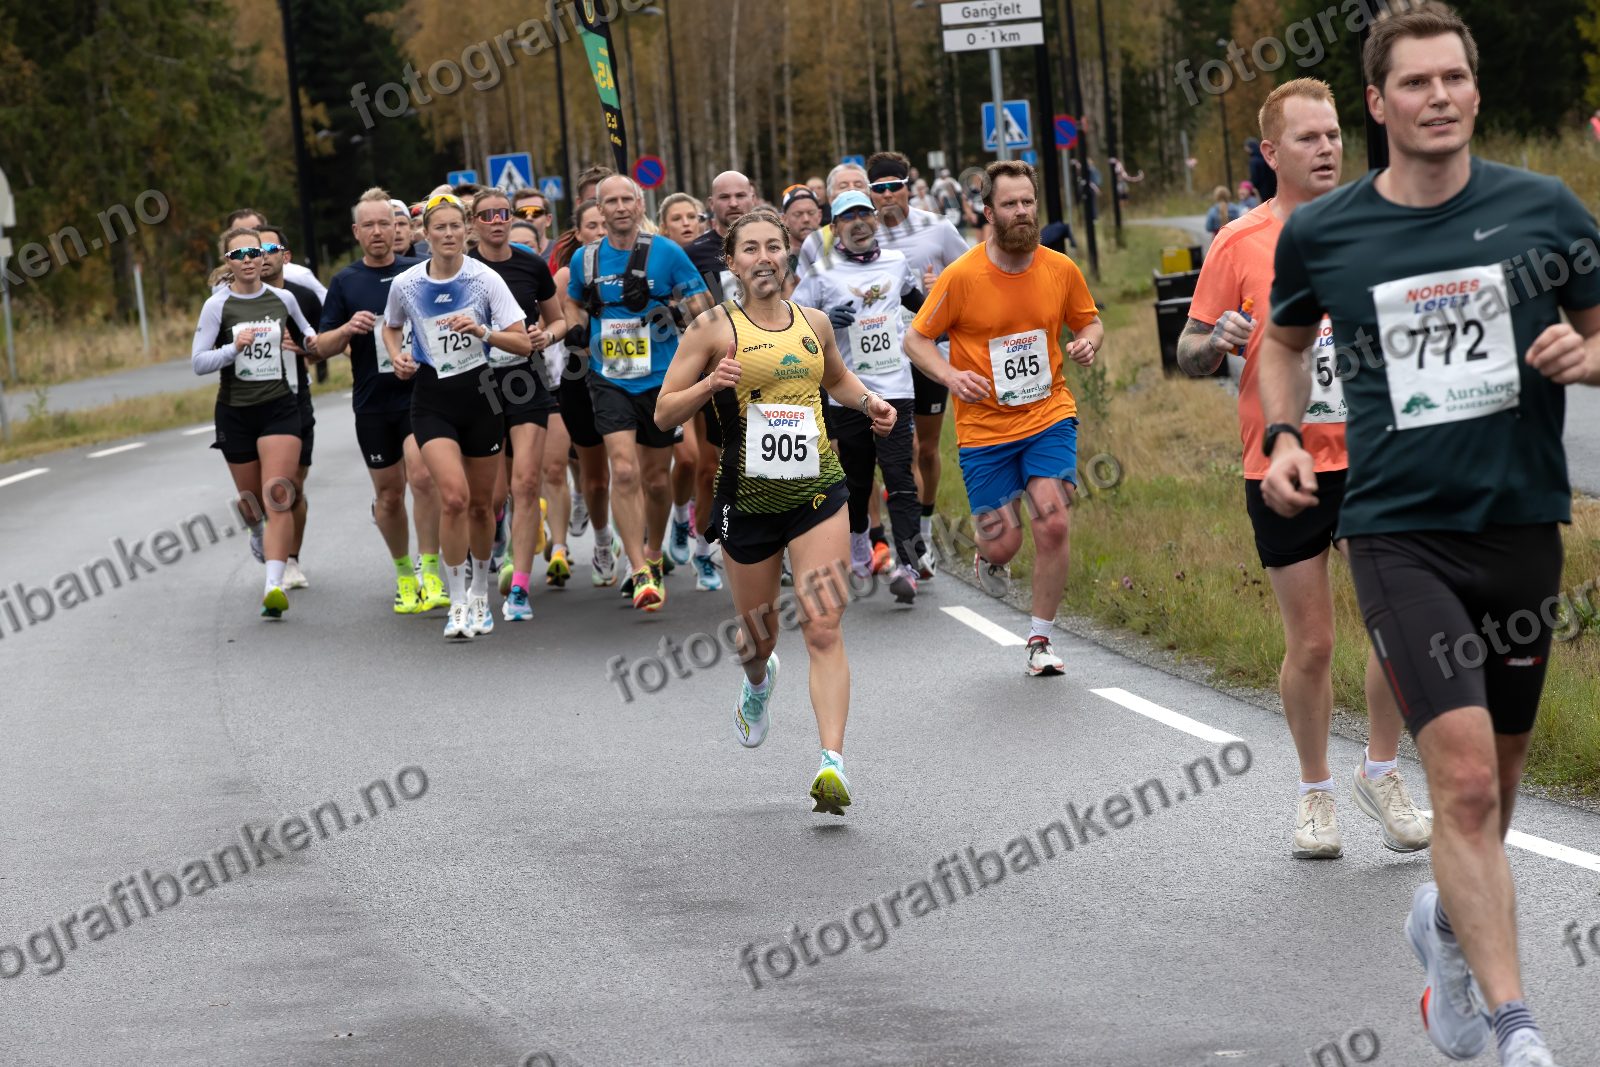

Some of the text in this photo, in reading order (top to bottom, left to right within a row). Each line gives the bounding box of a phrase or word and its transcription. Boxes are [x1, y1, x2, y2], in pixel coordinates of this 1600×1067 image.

[961, 4, 1021, 19] Gangfelt
[966, 33, 976, 45] 0
[991, 31, 996, 43] 1
[1000, 31, 1020, 42] km
[1405, 278, 1480, 303] NORGES
[1414, 295, 1470, 315] LØPET
[860, 315, 887, 326] NORGES
[863, 322, 884, 332] LØPET
[438, 333, 472, 355] 725
[605, 340, 646, 356] PACE
[743, 343, 768, 353] CRAFT
[861, 332, 891, 354] 628
[1003, 335, 1037, 348] NORGES
[1007, 343, 1033, 354] LØPET
[1408, 319, 1488, 370] 772
[244, 341, 272, 360] 452
[774, 366, 810, 377] Aurskog
[1004, 354, 1040, 381] 645
[1445, 380, 1516, 403] Aurskog
[764, 410, 805, 420] NORGES
[768, 419, 800, 427] LØPET
[761, 433, 808, 462] 905
